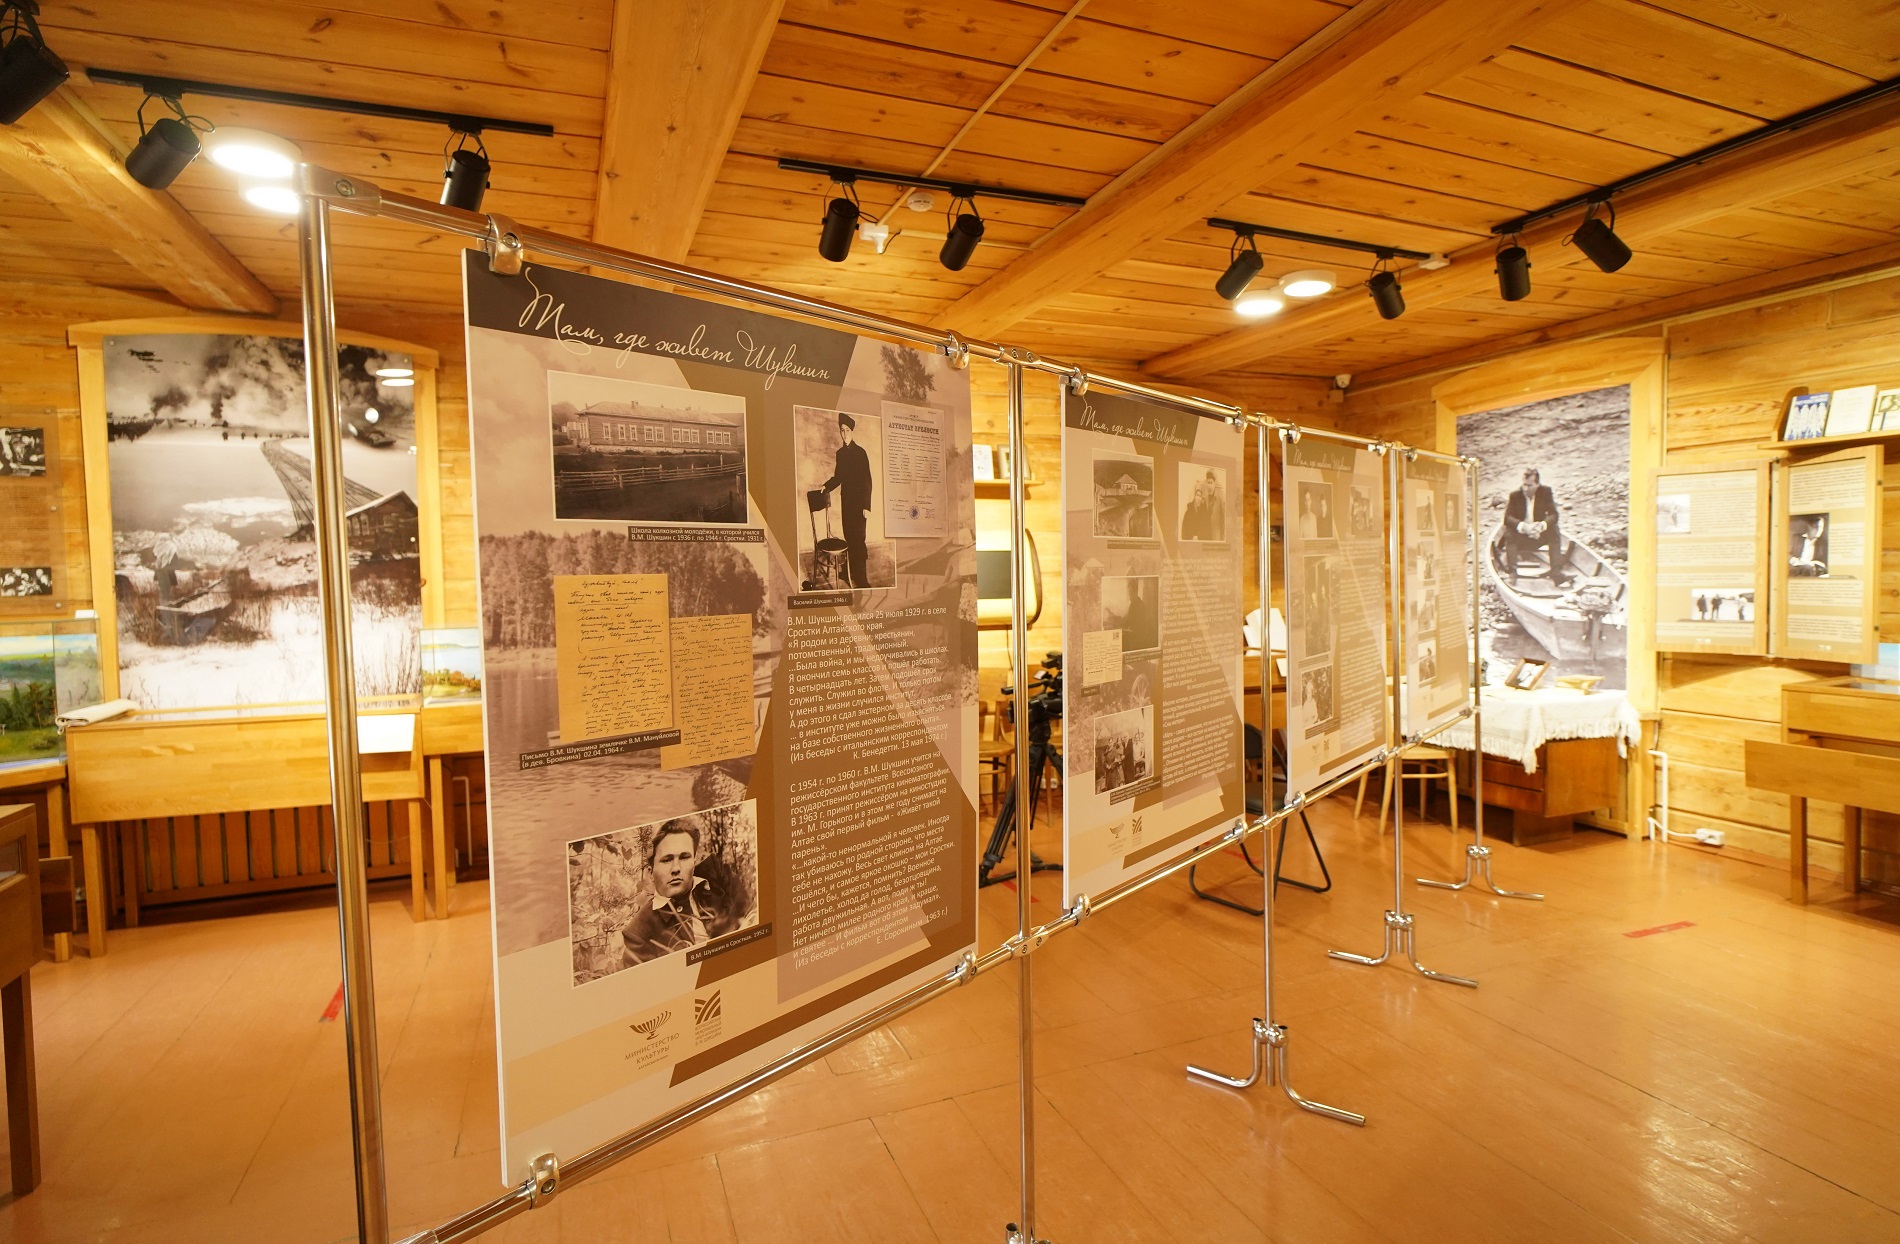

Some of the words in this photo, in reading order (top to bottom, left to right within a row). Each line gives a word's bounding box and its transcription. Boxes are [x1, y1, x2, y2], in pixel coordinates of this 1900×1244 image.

[518, 267, 604, 355] Там,
[613, 330, 649, 368] где
[655, 324, 734, 363] живет
[736, 330, 830, 390] Шукшин
[787, 616, 806, 625] В.М.
[808, 613, 841, 626] Шукшин
[843, 612, 873, 623] родился
[875, 610, 883, 618] 25
[885, 610, 903, 618] июля
[905, 608, 920, 616] 1929
[788, 626, 820, 639] Сростки
[822, 622, 864, 634] Алтайского
[866, 622, 884, 632] края.
[788, 645, 852, 661] потомственный,
[800, 638, 826, 649] родом
[796, 671, 829, 682] окончил
[832, 668, 850, 677] семь
[852, 664, 879, 674] классов
[819, 656, 844, 669] война,
[789, 694, 824, 707] служить.
[826, 687, 855, 701] Служил
[868, 682, 890, 695] флоте.
[796, 679, 851, 695] четырнадцать
[796, 706, 816, 715] меня
[825, 700, 849, 710] жизни
[851, 695, 883, 708] случился
[810, 715, 830, 724] этого
[838, 710, 856, 720] сдал
[858, 703, 894, 718] экстерном
[802, 737, 820, 748] базе
[822, 726, 872, 744] собственного
[874, 720, 914, 734] жизненного
[806, 723, 843, 738] институте
[861, 715, 885, 726] можно
[888, 710, 905, 721] было
[521, 752, 548, 761] Письмо
[550, 748, 564, 756] В.М.
[566, 744, 598, 755] Шукшина
[600, 740, 628, 749] землячке
[628, 736, 642, 744] В.М.
[644, 731, 680, 743] Мануйловой
[806, 744, 834, 760] беседы
[843, 735, 888, 750] итальянским
[862, 741, 899, 758] Бенедетти.
[901, 739, 908, 748] 13
[924, 733, 939, 743] 1974
[790, 782, 847, 806] режиссёрском
[849, 772, 888, 791] факультете
[891, 760, 933, 778] Всесоюзного
[798, 778, 816, 791] 1954
[838, 769, 855, 781] 1960
[864, 763, 879, 775] В.М.
[881, 756, 909, 772] Шукшин
[911, 753, 931, 765] учится
[790, 791, 859, 817] государственного
[861, 782, 894, 798] института
[798, 811, 817, 824] 1963
[827, 803, 852, 818] принят
[855, 790, 898, 810] режиссёром
[909, 778, 946, 795] киностудию
[819, 812, 852, 831] Горького
[896, 797, 910, 809] году
[912, 790, 937, 802] снимает
[791, 834, 814, 849] Алтае
[816, 828, 834, 841] свой
[836, 819, 864, 837] первый
[866, 812, 888, 828] фильм
[922, 797, 940, 809] такой
[838, 831, 891, 857] ненормальной
[898, 822, 926, 836] человек.
[927, 813, 949, 828] Иногда
[792, 871, 804, 882] так
[806, 857, 844, 879] убиваюсь
[856, 844, 882, 862] родной
[885, 836, 913, 852] стороне,
[926, 826, 944, 837] места
[792, 879, 810, 893] себе
[824, 866, 853, 884] нахожу.
[855, 858, 871, 871] Весь
[873, 854, 887, 865] свет
[889, 845, 914, 859] клином
[924, 834, 942, 847] Алтае
[792, 884, 827, 905] сошёлся,
[836, 874, 858, 888] самое
[861, 866, 881, 881] яркое
[883, 857, 908, 871] окошко
[807, 898, 823, 910] чего
[841, 880, 871, 898] кажется,
[873, 866, 905, 885] помнить?
[908, 856, 934, 873] Военное
[792, 904, 834, 928] лихолетье,
[836, 895, 858, 911] холод
[870, 883, 892, 898] голод,
[926, 910, 939, 922] 1963
[792, 918, 819, 939] работа
[822, 902, 868, 927] двужильная.
[793, 934, 807, 947] Нет
[809, 925, 835, 941] ничего
[838, 915, 860, 930] милее
[862, 903, 891, 922] родного
[843, 921, 867, 940] фильм
[810, 943, 838, 963] беседы
[624, 1032, 680, 1060] МИНИСТЕРСТВО
[636, 1045, 670, 1064] КУЛЬТУРЫ
